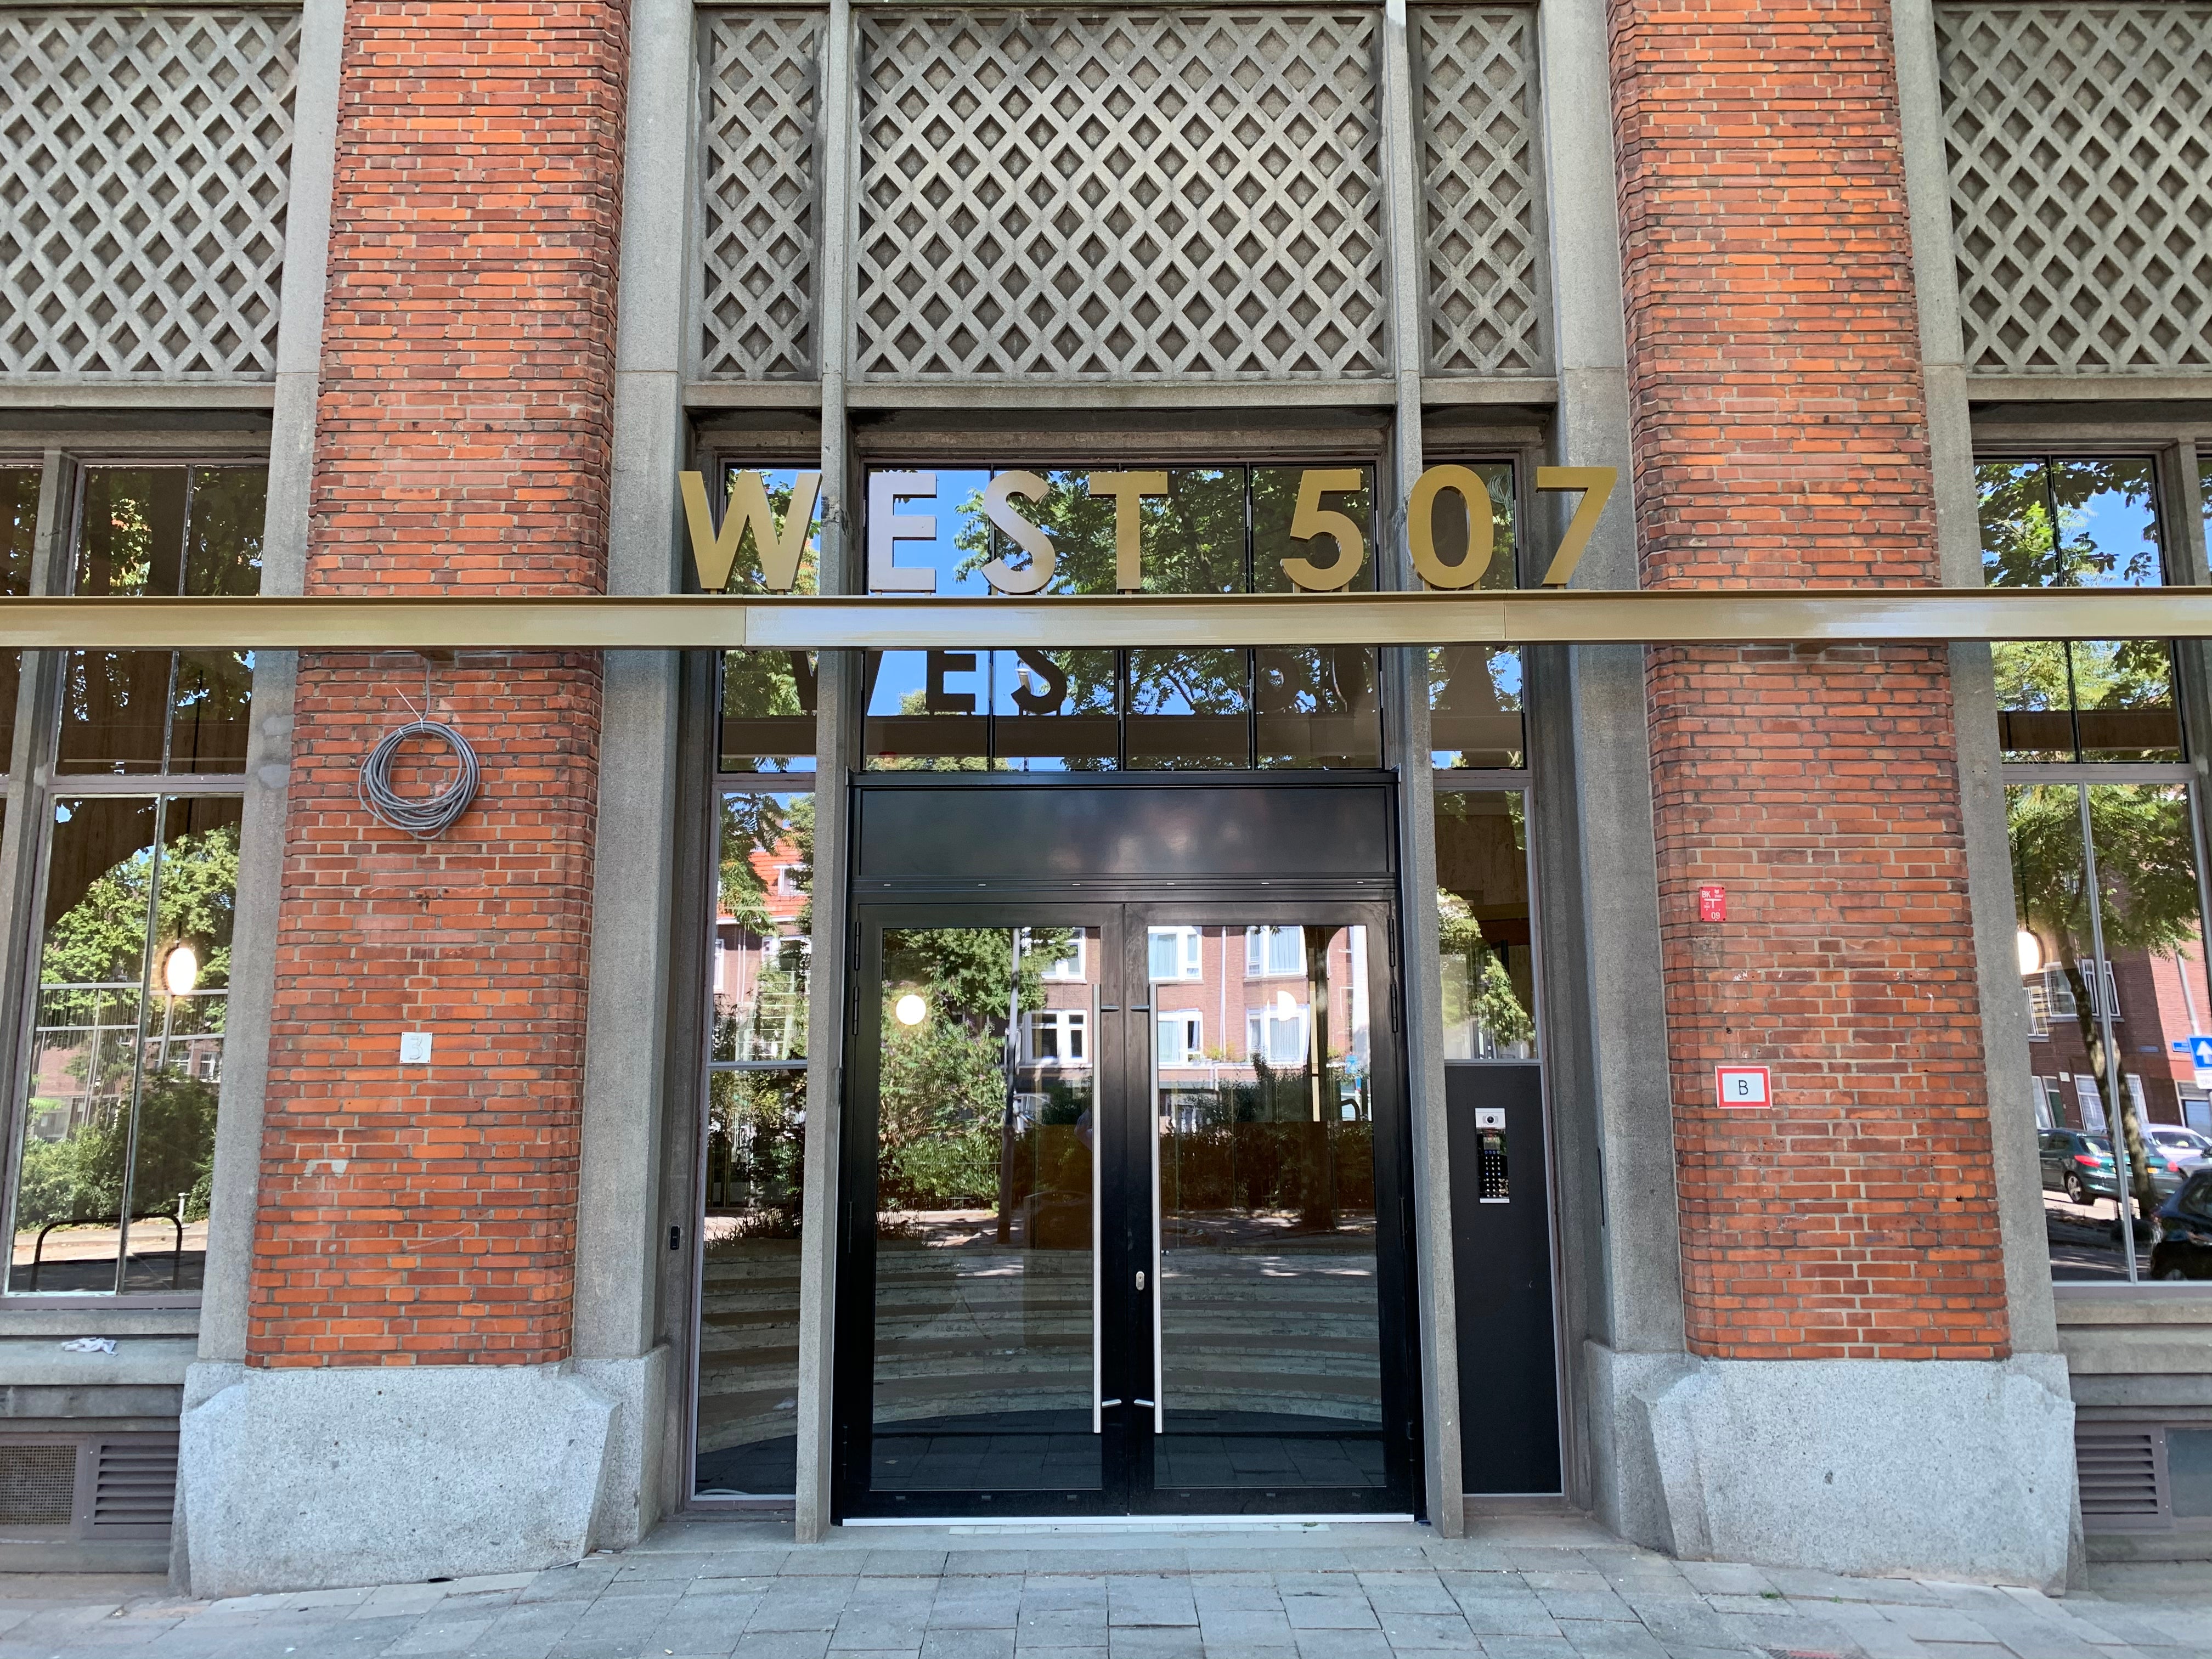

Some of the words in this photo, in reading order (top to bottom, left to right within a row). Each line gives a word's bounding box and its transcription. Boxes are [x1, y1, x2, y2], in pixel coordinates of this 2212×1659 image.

[679, 471, 1168, 594] WEST
[1280, 465, 1617, 591] 507
[1711, 911, 1720, 919] 09
[408, 1035, 423, 1060] 3
[1739, 1080, 1748, 1095] B
